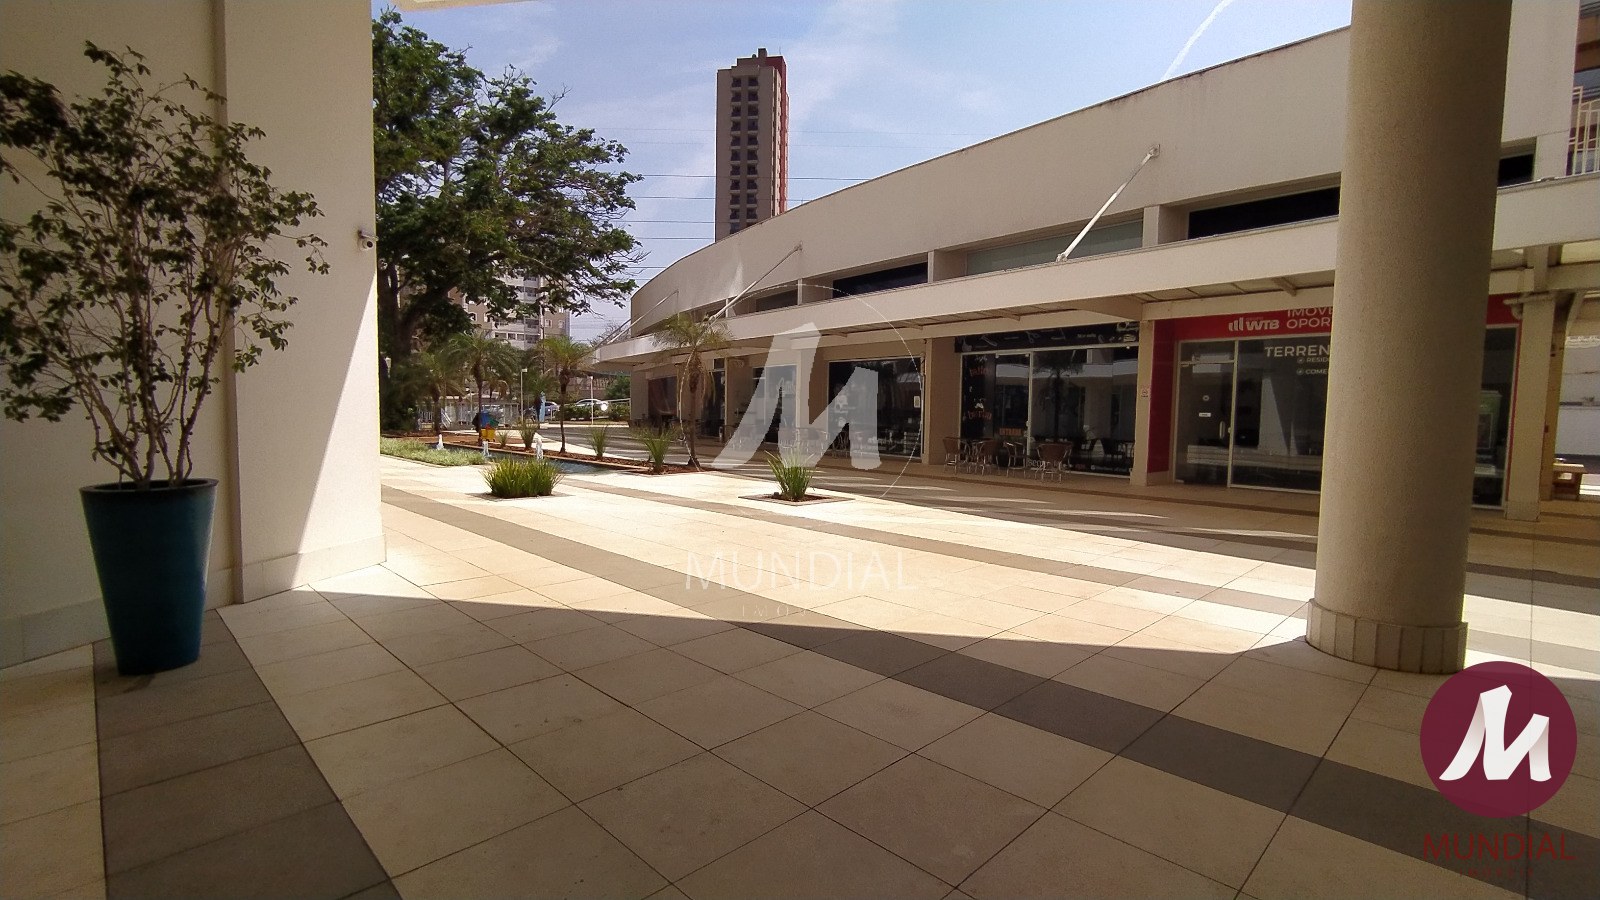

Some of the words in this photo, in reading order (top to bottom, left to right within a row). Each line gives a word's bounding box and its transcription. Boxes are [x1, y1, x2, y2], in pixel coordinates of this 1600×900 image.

[1245, 319, 1280, 331] WTB
[1286, 316, 1331, 329] OPOR
[1264, 344, 1330, 358] TERREN
